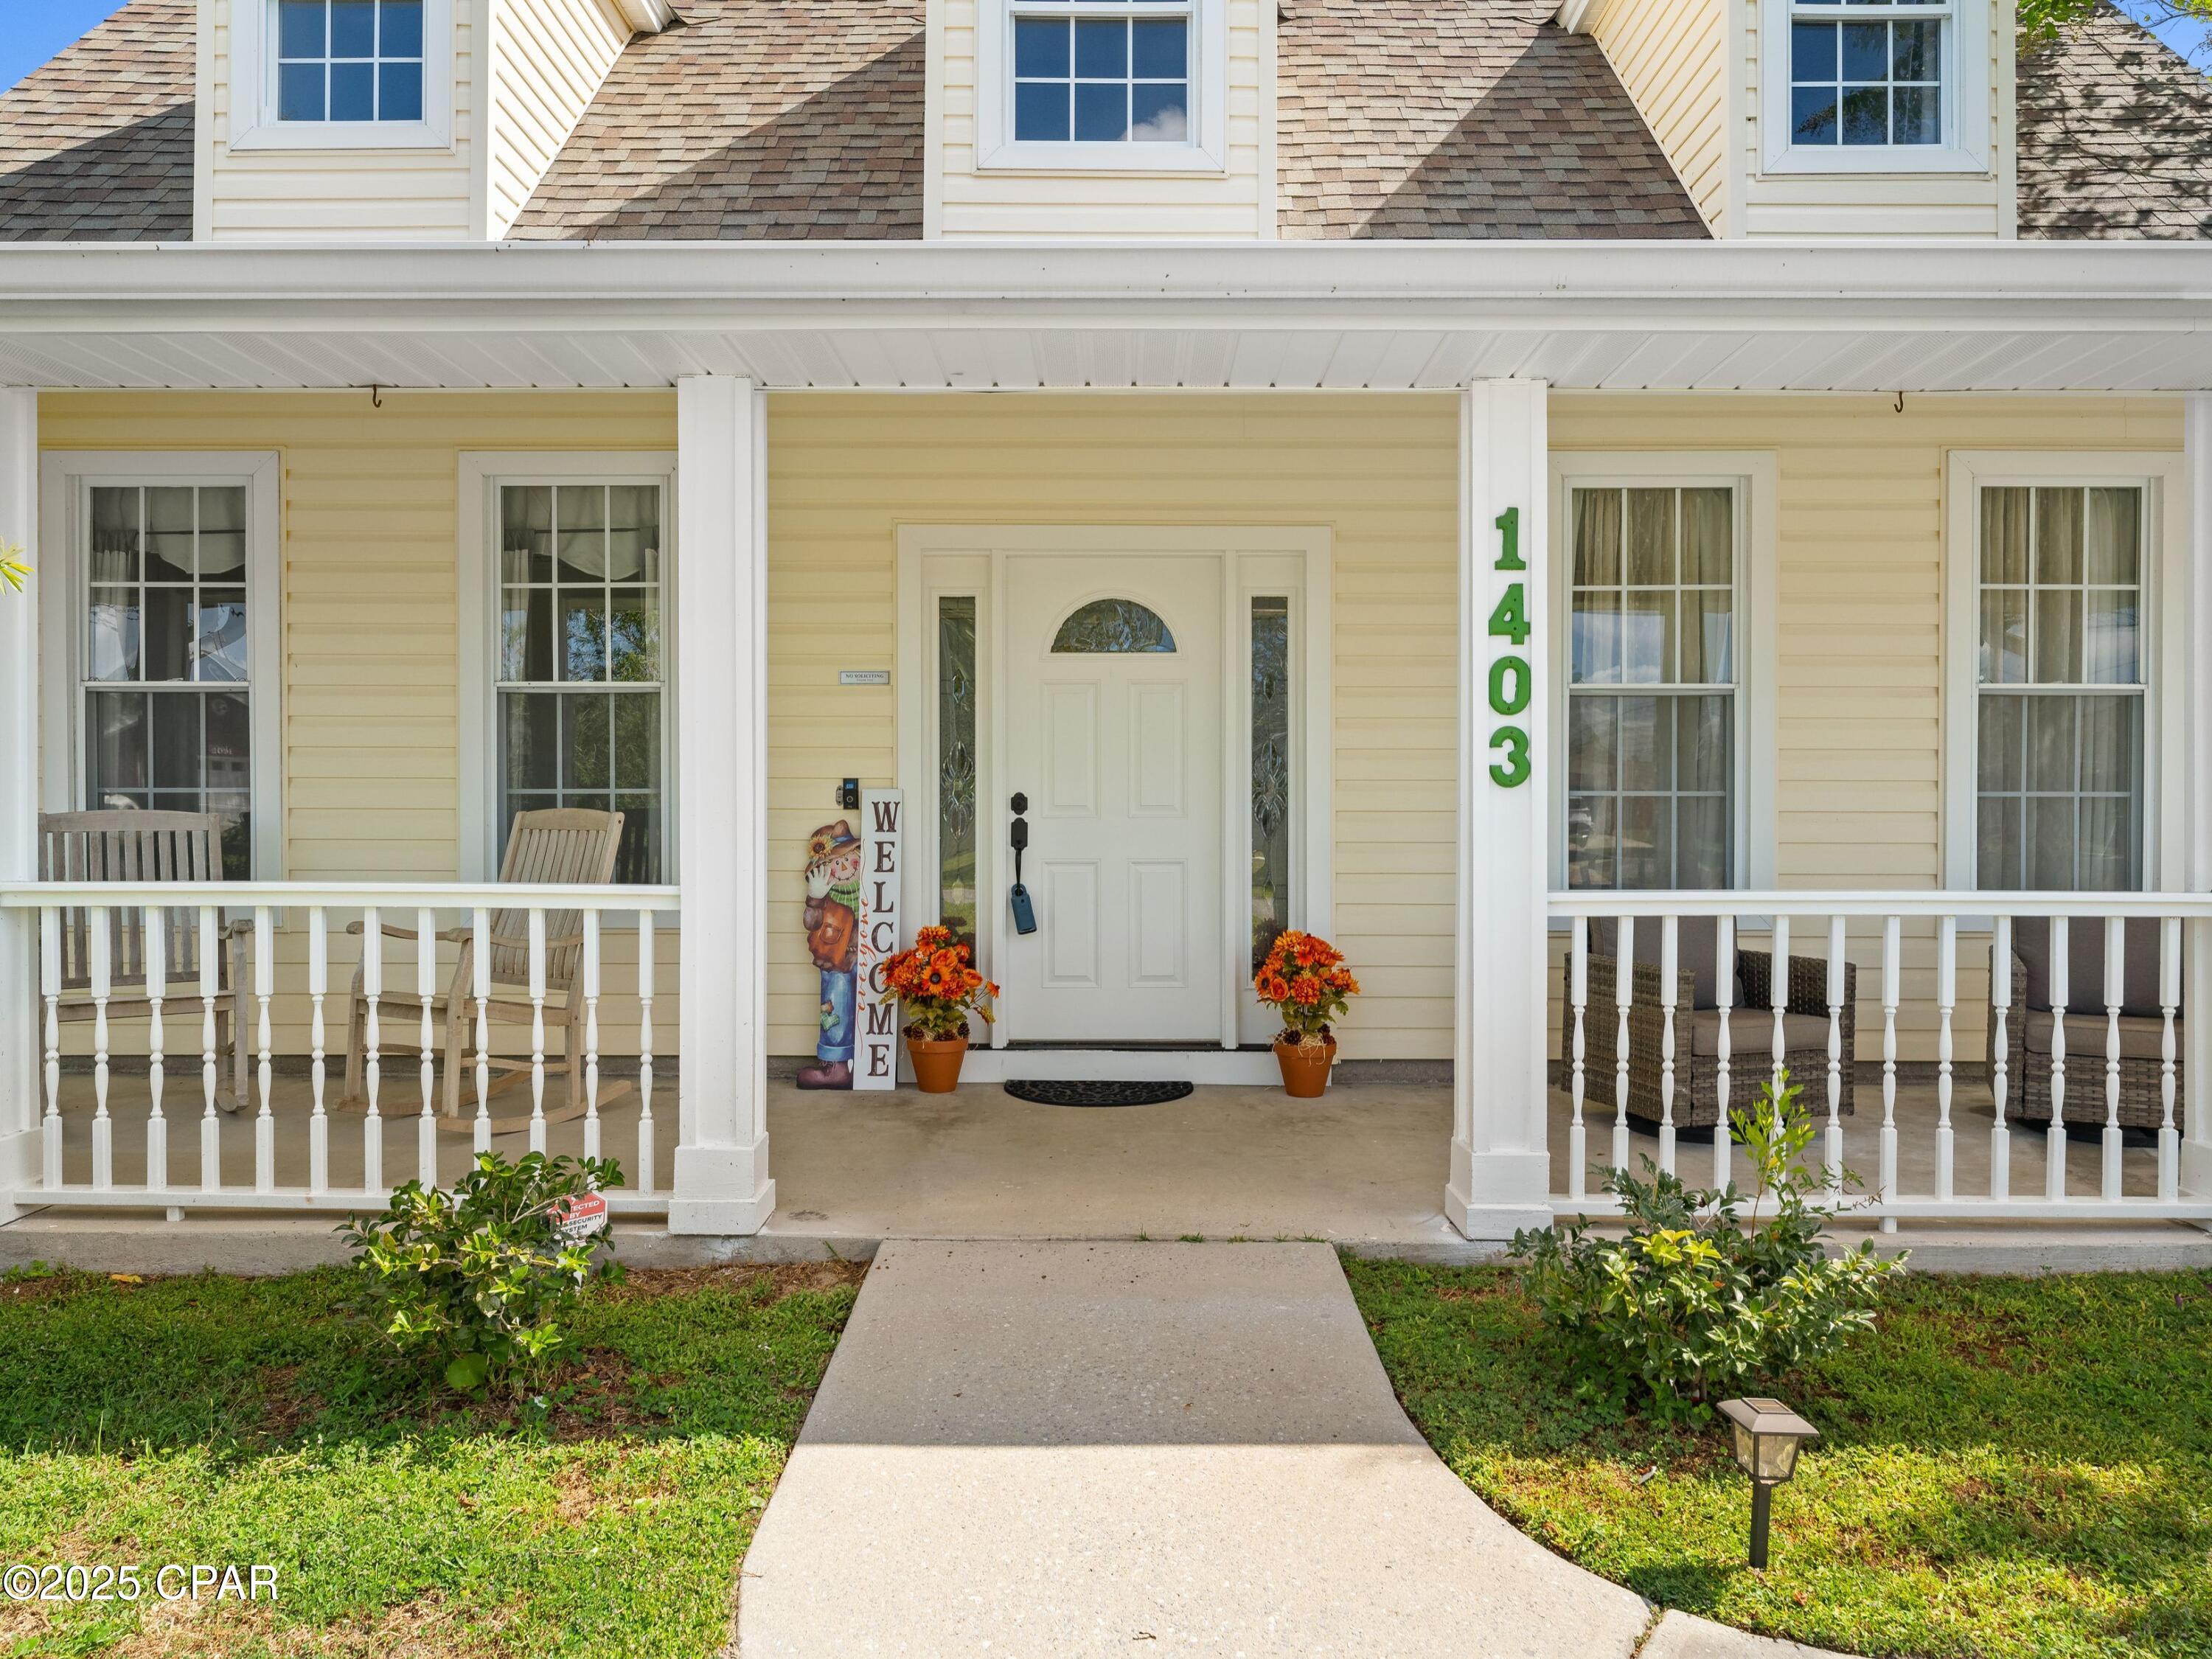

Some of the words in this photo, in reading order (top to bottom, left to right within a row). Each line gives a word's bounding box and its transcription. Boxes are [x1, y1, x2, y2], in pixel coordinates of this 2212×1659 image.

[1488, 507, 1531, 788] 1403
[858, 897, 877, 1012] everyone
[866, 801, 900, 1077] WELCOME
[563, 1224, 588, 1233] YSTEM
[569, 1214, 602, 1225] SECURITY
[571, 1200, 600, 1211] TECTED
